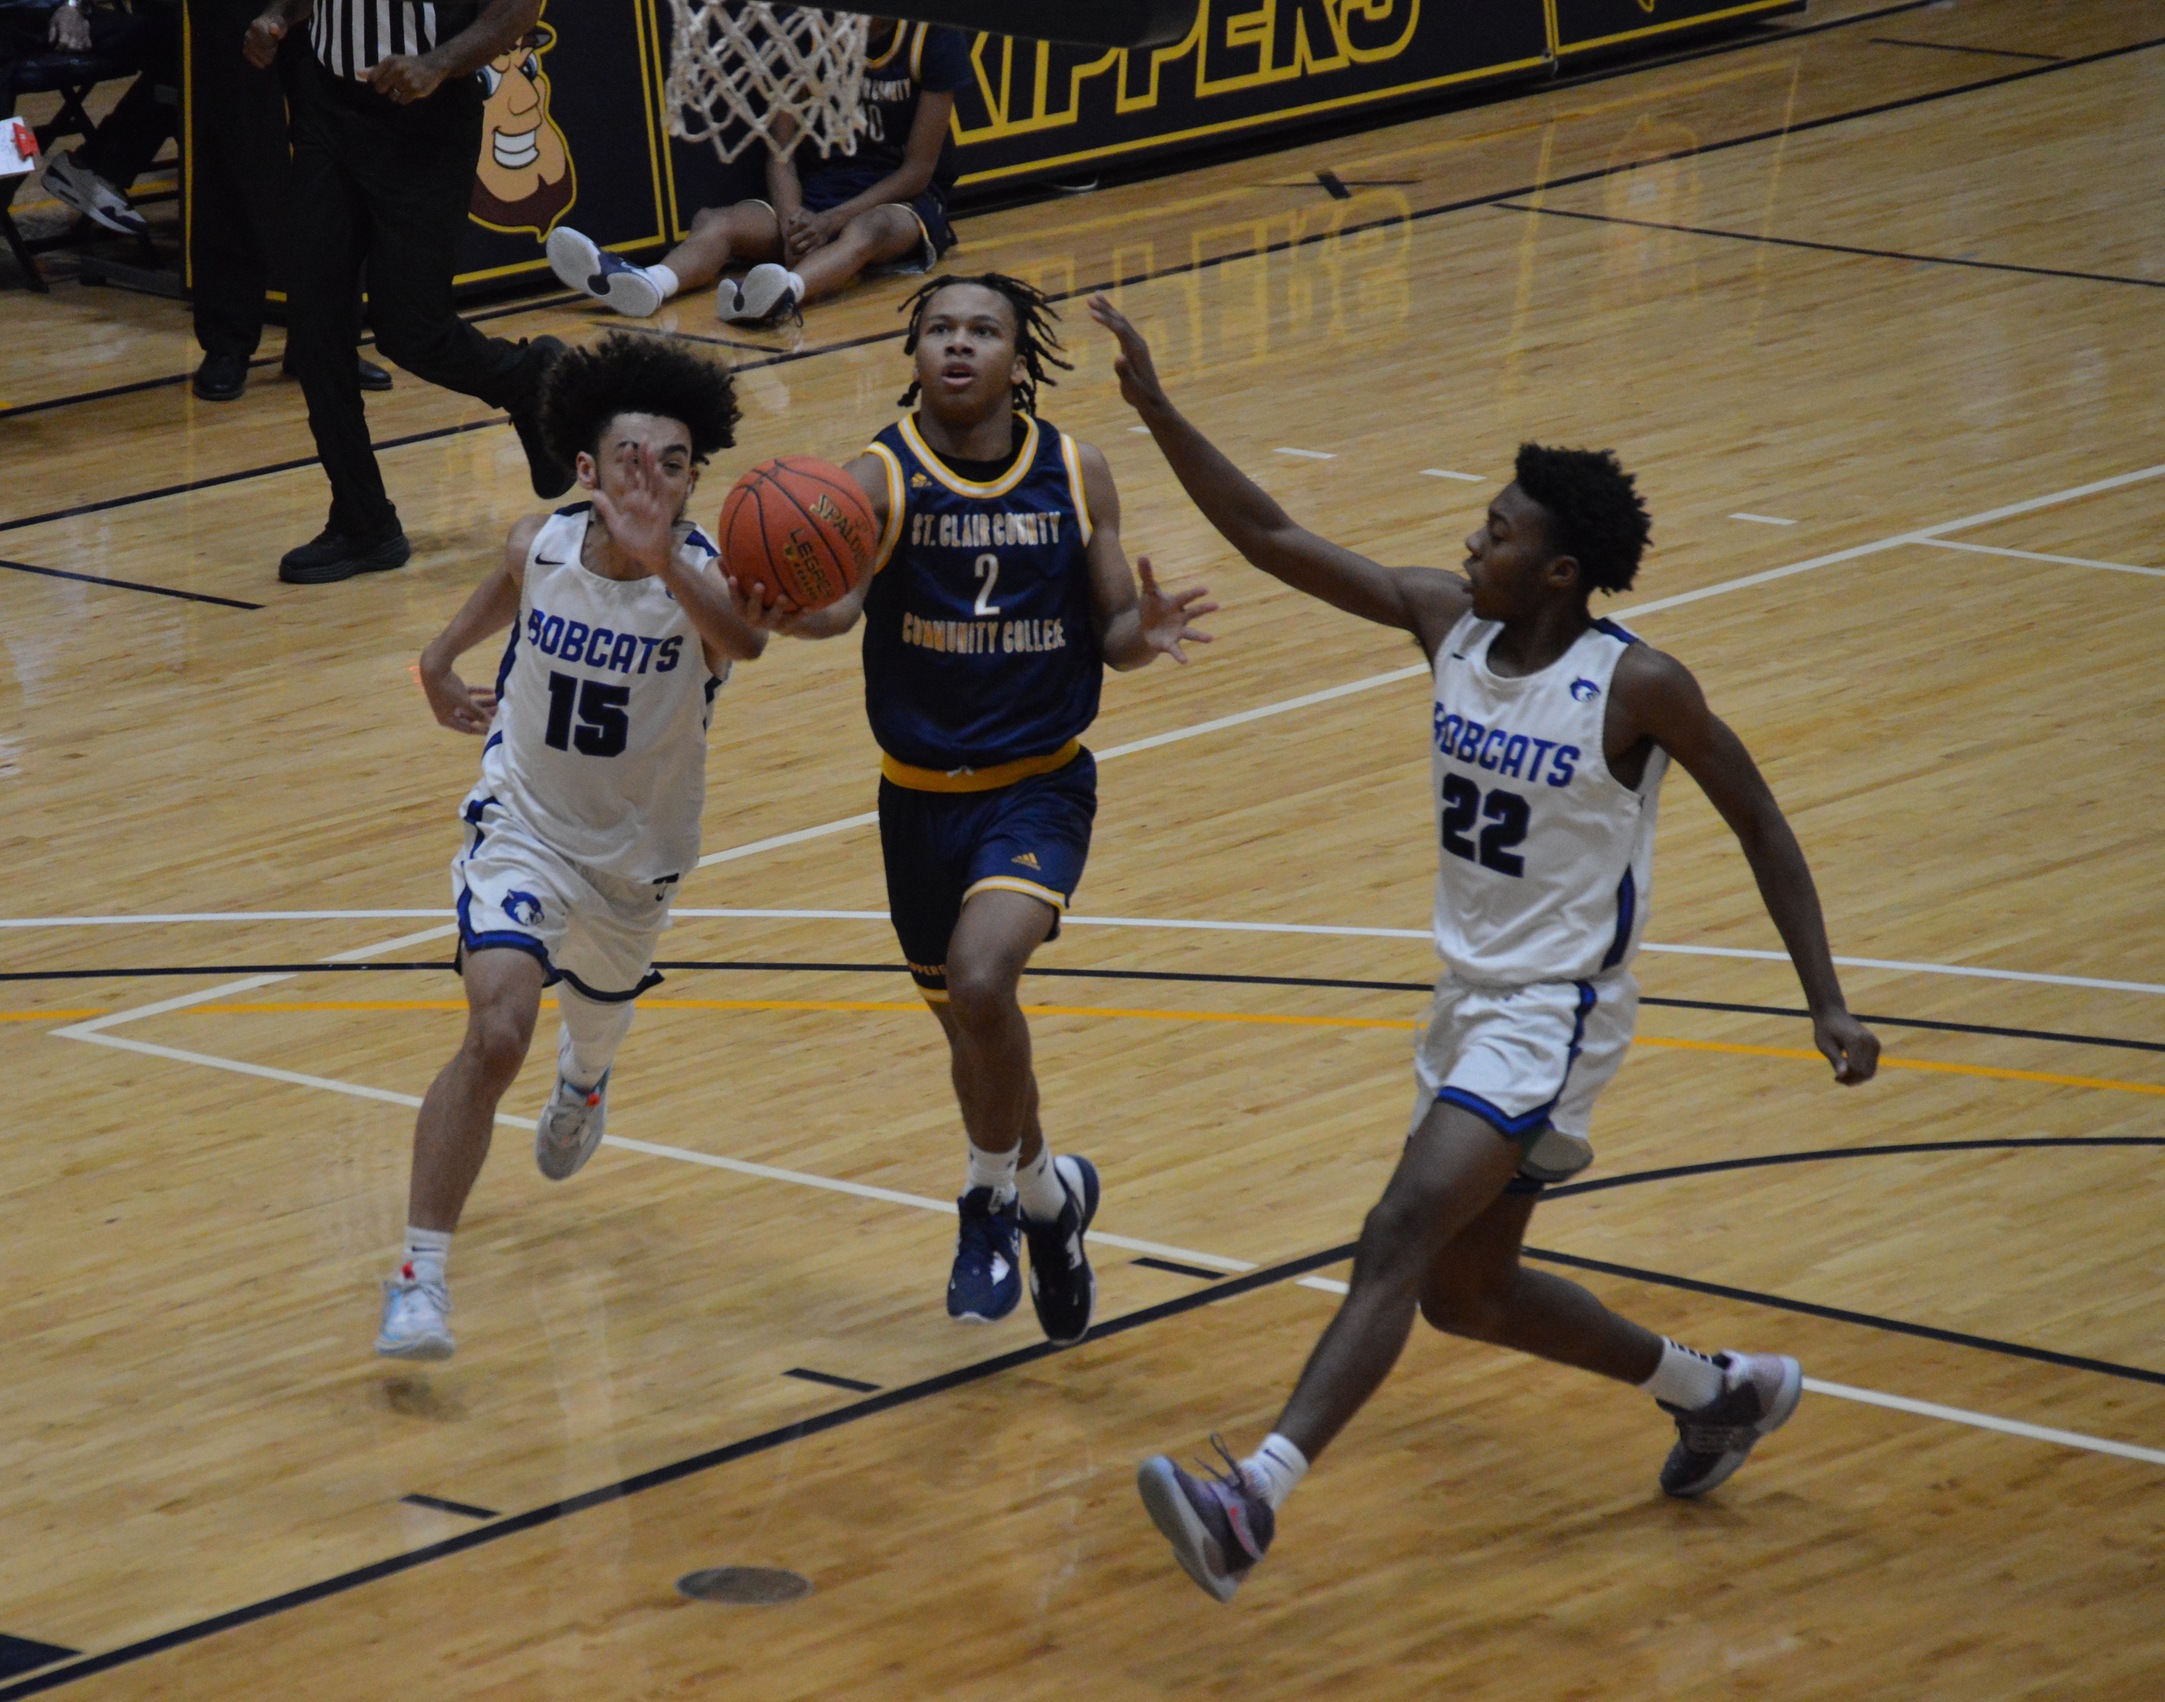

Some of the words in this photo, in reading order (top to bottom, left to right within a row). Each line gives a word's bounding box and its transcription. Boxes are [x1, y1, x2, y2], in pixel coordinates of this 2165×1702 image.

[911, 512, 937, 546] ST.
[939, 513, 991, 548] CLAIR
[992, 511, 1061, 547] COUNTY
[973, 552, 1002, 617] 2
[527, 608, 684, 675] BOBCATS
[901, 611, 999, 655] COMMUNITY
[545, 671, 631, 758] 15
[1442, 772, 1531, 878] 22
